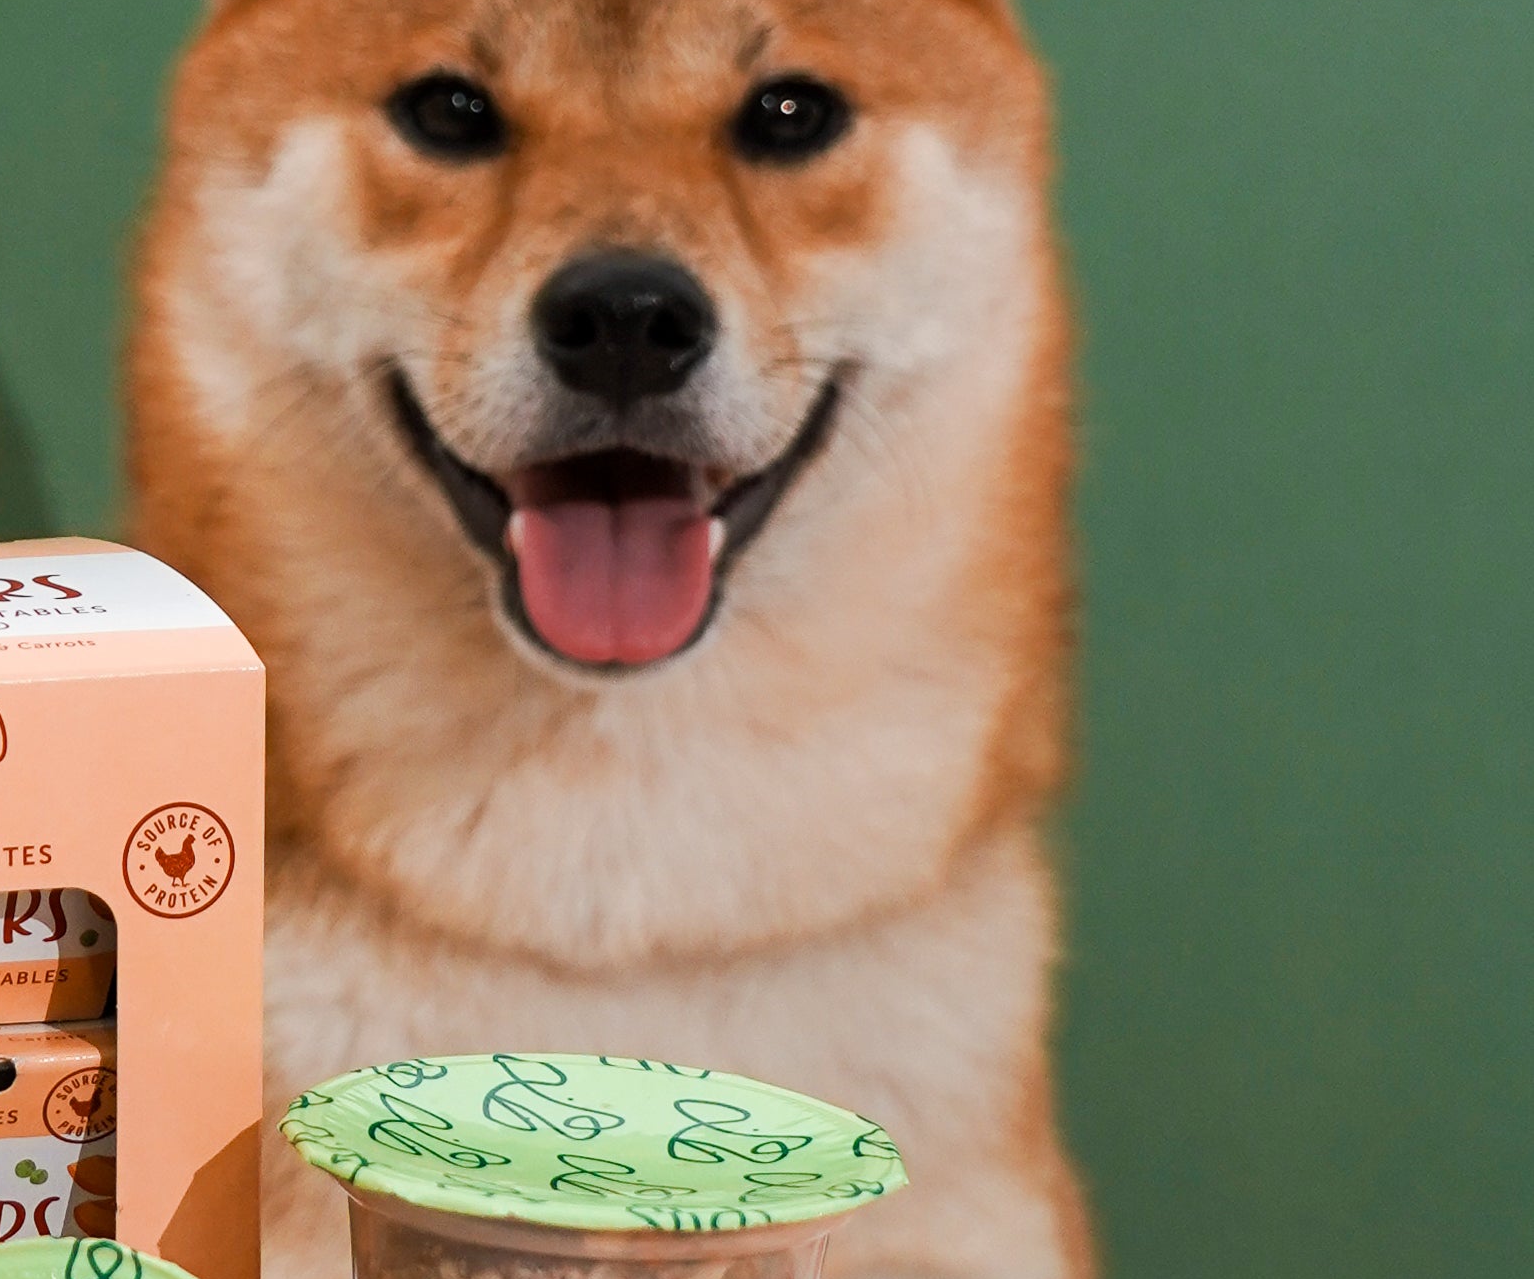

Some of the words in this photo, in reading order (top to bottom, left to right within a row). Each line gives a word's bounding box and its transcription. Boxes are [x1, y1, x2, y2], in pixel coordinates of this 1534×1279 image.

[18, 639, 96, 650] Carrots
[137, 812, 201, 851] SOURCE
[202, 826, 223, 846] OF
[144, 874, 218, 908] PROTEIN
[56, 1074, 109, 1100] SOURCE
